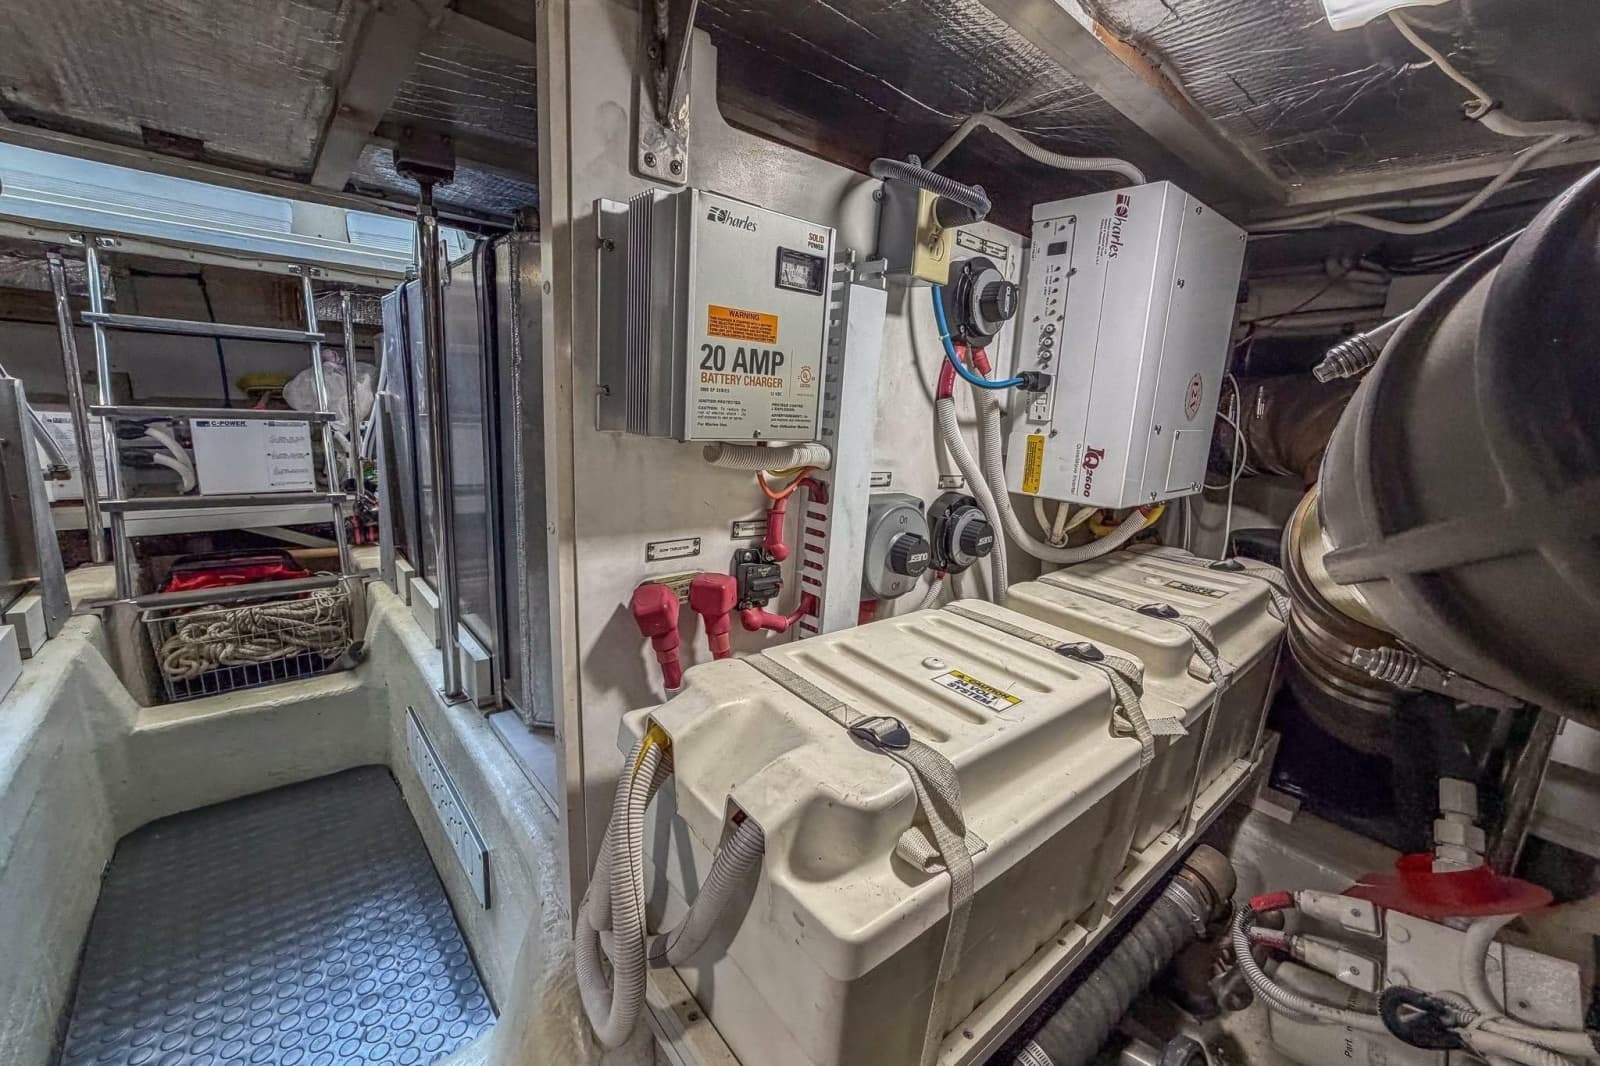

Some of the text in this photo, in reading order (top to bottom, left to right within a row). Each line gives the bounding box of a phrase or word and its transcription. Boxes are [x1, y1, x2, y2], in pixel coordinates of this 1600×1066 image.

[716, 208, 758, 232] Charles
[808, 232, 825, 243] SOLID
[1108, 205, 1129, 259] Charles
[807, 241, 824, 251] POWER
[728, 309, 760, 321] WARNING
[699, 343, 785, 377] 20 AMP
[700, 371, 742, 386] BATTERY
[743, 375, 784, 389] CHARGER
[947, 682, 993, 705] SYSTEM
[970, 685, 998, 701] VOLT
